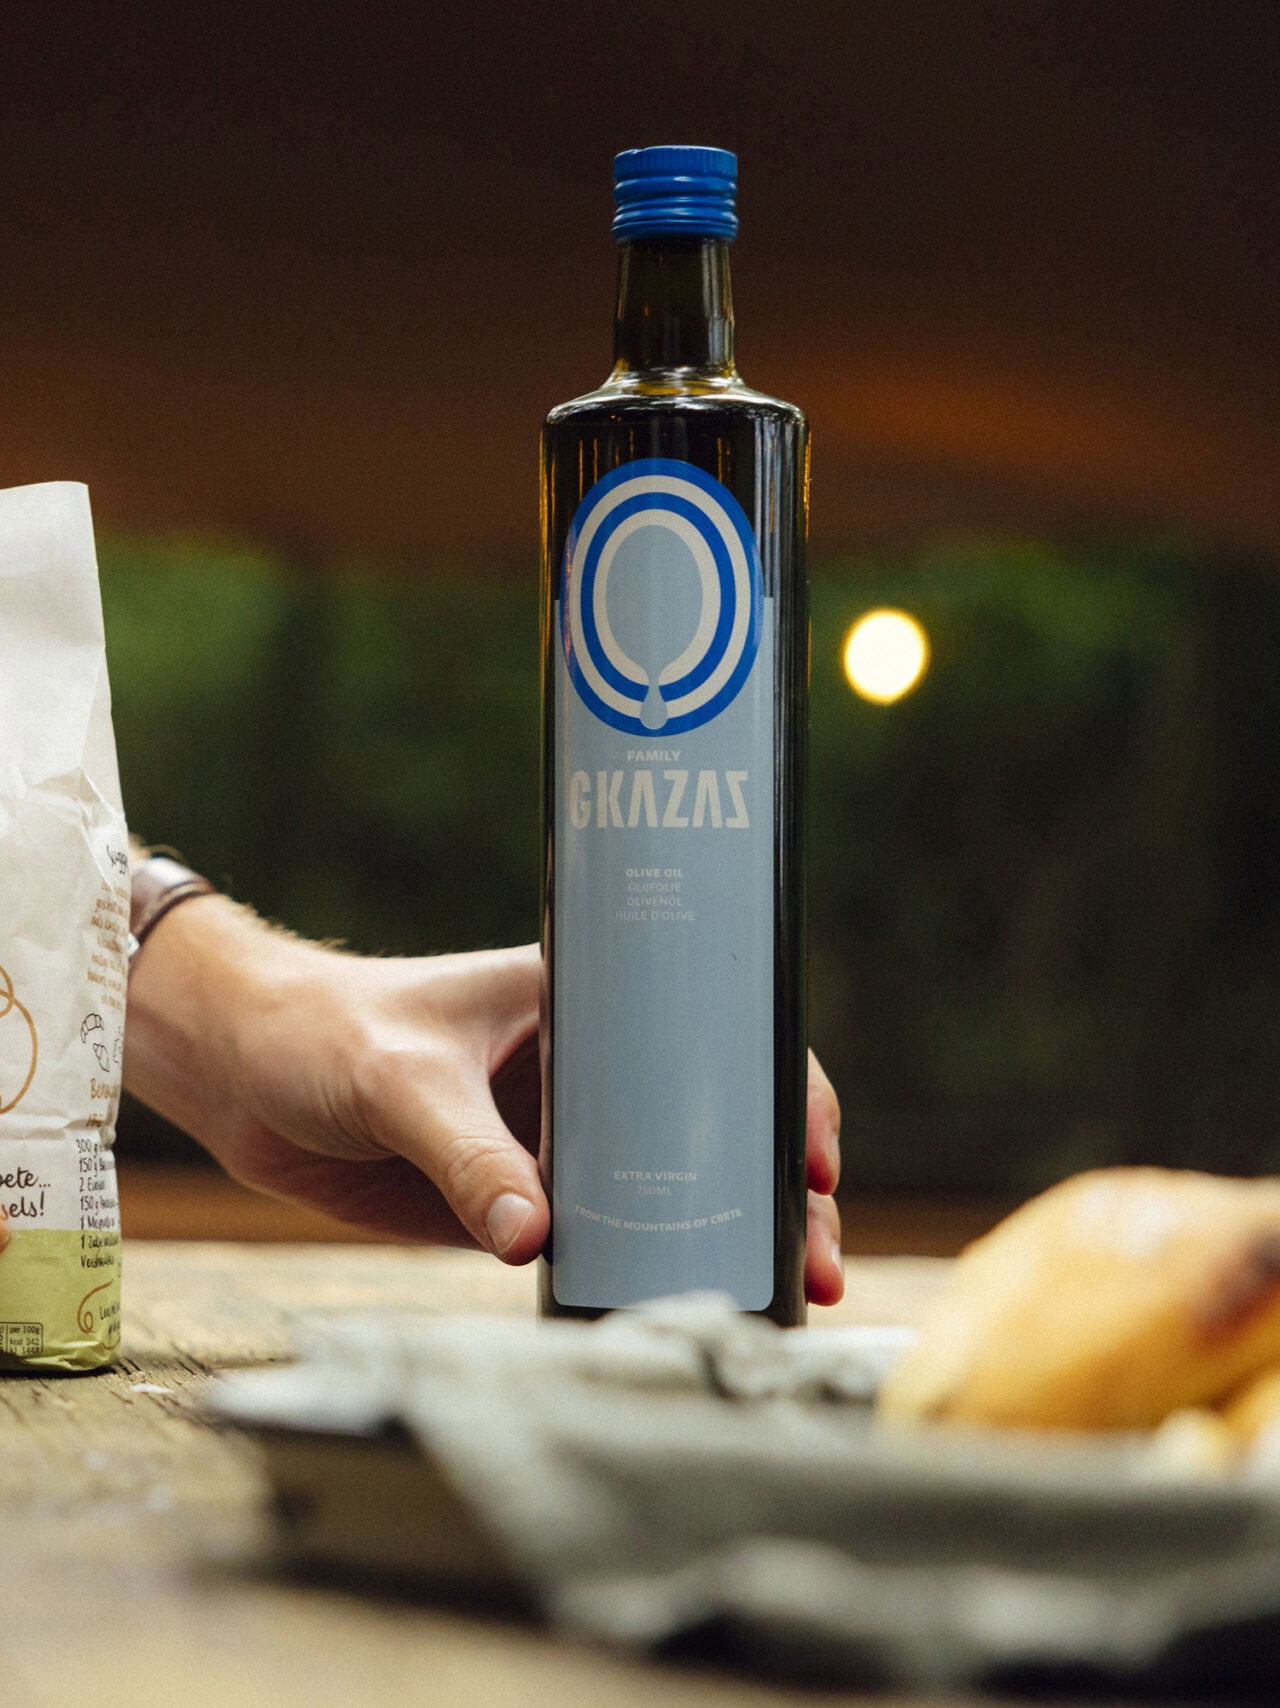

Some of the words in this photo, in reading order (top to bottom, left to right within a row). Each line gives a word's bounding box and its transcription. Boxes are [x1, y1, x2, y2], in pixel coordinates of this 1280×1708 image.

[626, 750, 681, 762] FAMILY
[625, 868, 661, 878] OLIVE
[663, 868, 684, 878] OIL
[615, 910, 647, 921] HUILE
[614, 1170, 652, 1181] EXTRA
[654, 1171, 697, 1182] VIRGIN
[574, 1204, 601, 1223] FROM
[602, 1214, 622, 1228] THE
[623, 1218, 692, 1232] MOUNTAINS
[693, 1216, 709, 1229] OF
[710, 1207, 744, 1225] CRETE
[9, 1327, 21, 1335] per
[23, 1325, 40, 1335] 100g
[25, 1337, 40, 1346] 342
